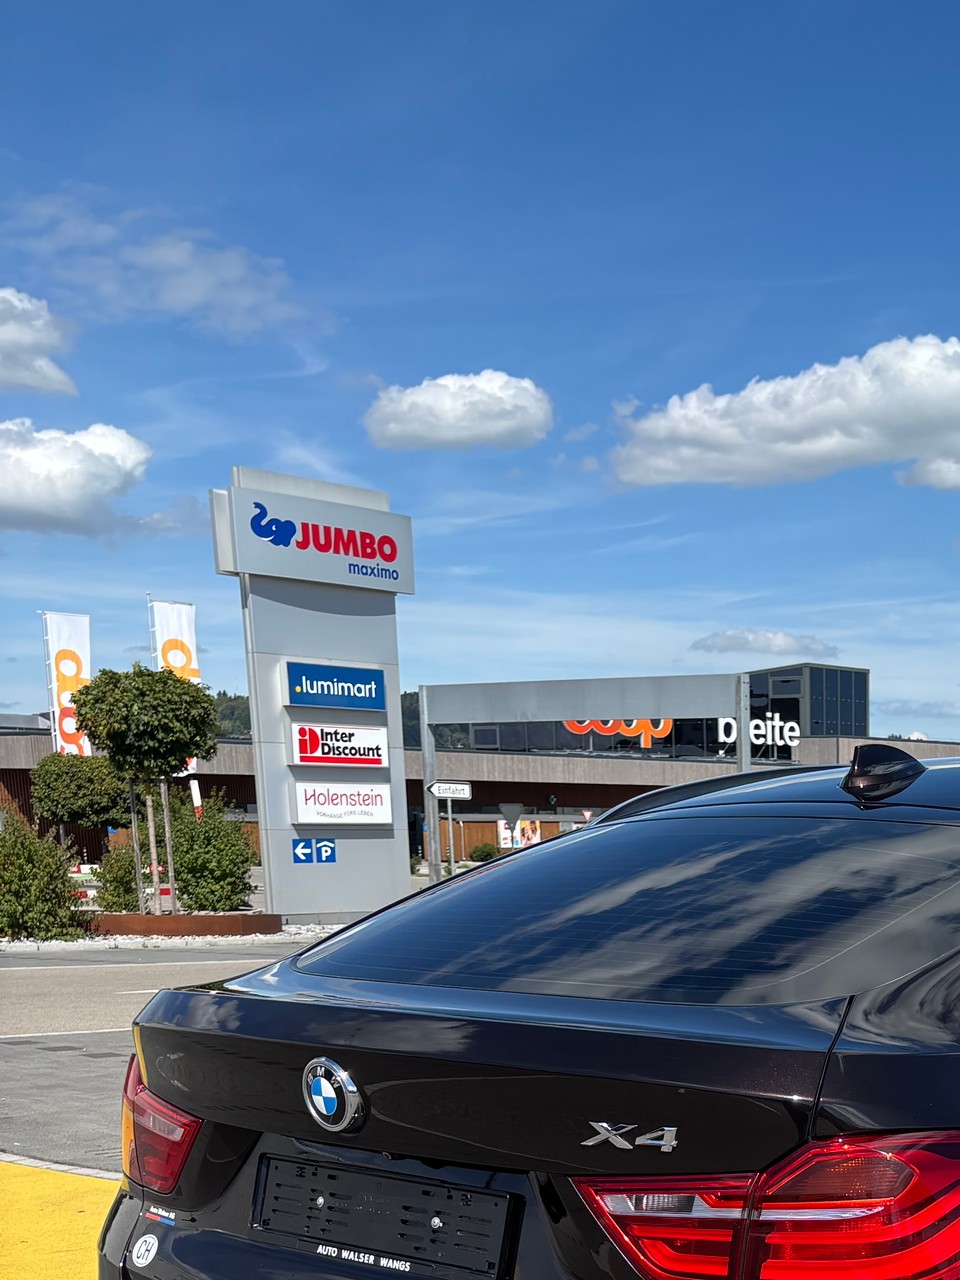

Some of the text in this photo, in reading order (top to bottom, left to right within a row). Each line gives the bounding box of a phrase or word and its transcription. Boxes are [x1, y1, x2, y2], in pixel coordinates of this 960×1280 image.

[295, 522, 398, 563] JUMBO
[348, 563, 399, 581] maximo
[320, 728, 355, 743] Inter
[718, 711, 801, 747] beite
[320, 742, 382, 758] Discount
[304, 788, 384, 807] Holenstein
[437, 785, 466, 796] Einfahrt
[307, 1066, 341, 1089] BMW
[580, 1121, 678, 1152] X4
[136, 1239, 155, 1261] CH
[316, 1244, 411, 1272] AUTO WALSER WANGS
